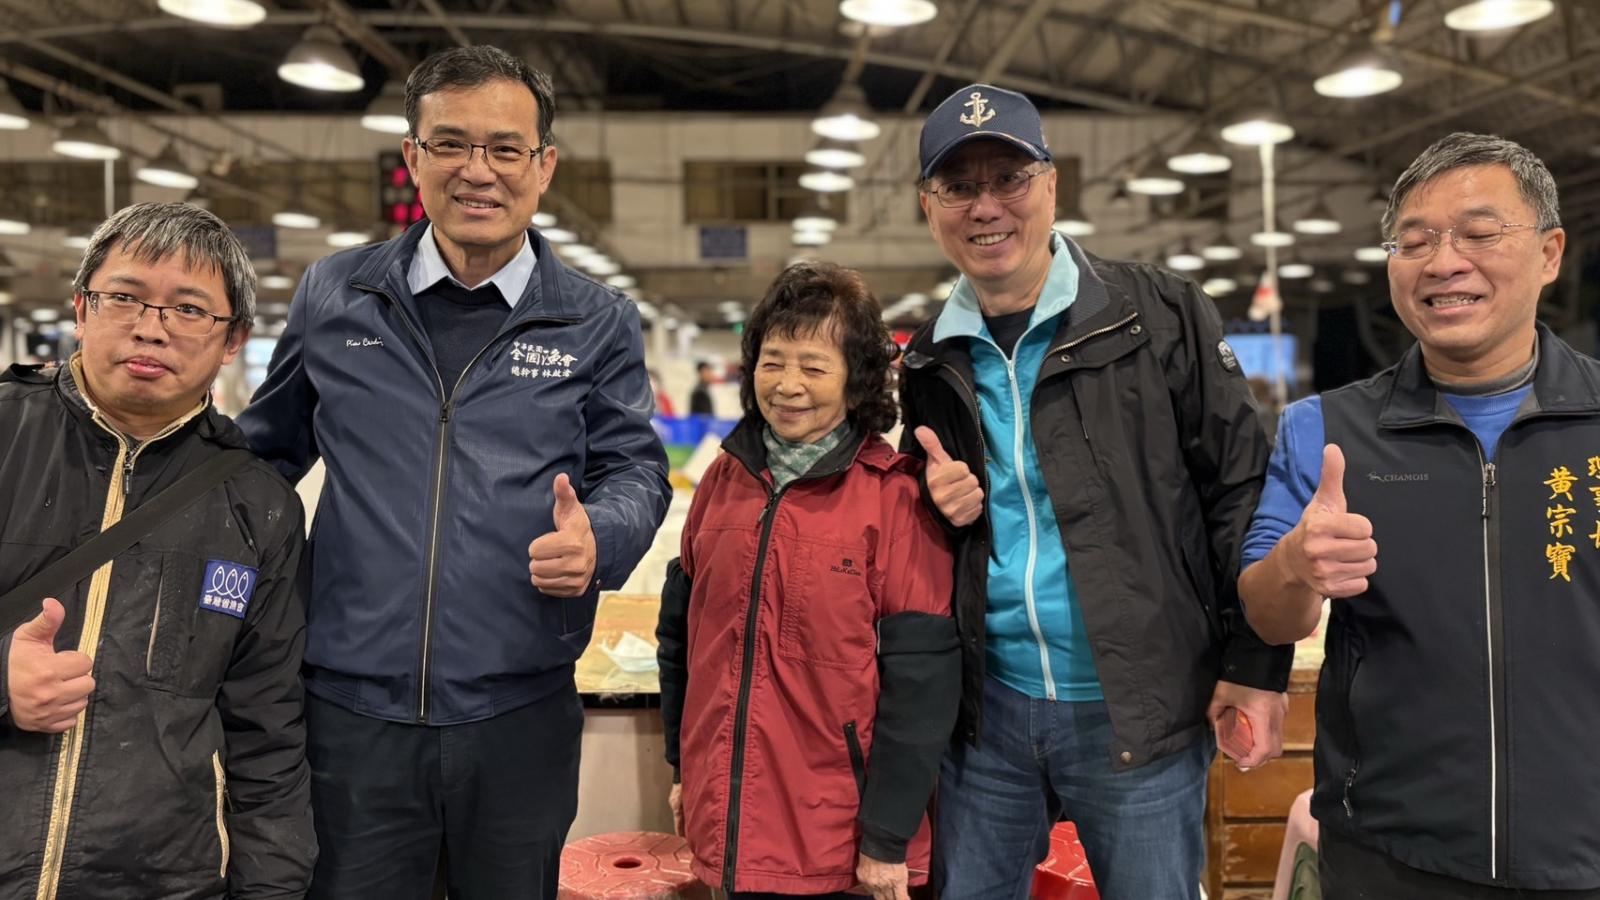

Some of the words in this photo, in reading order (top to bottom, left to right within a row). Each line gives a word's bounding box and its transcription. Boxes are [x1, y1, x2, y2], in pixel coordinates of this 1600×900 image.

[509, 348, 578, 367] 全國漁會
[1543, 466, 1578, 582] 黃宗寶
